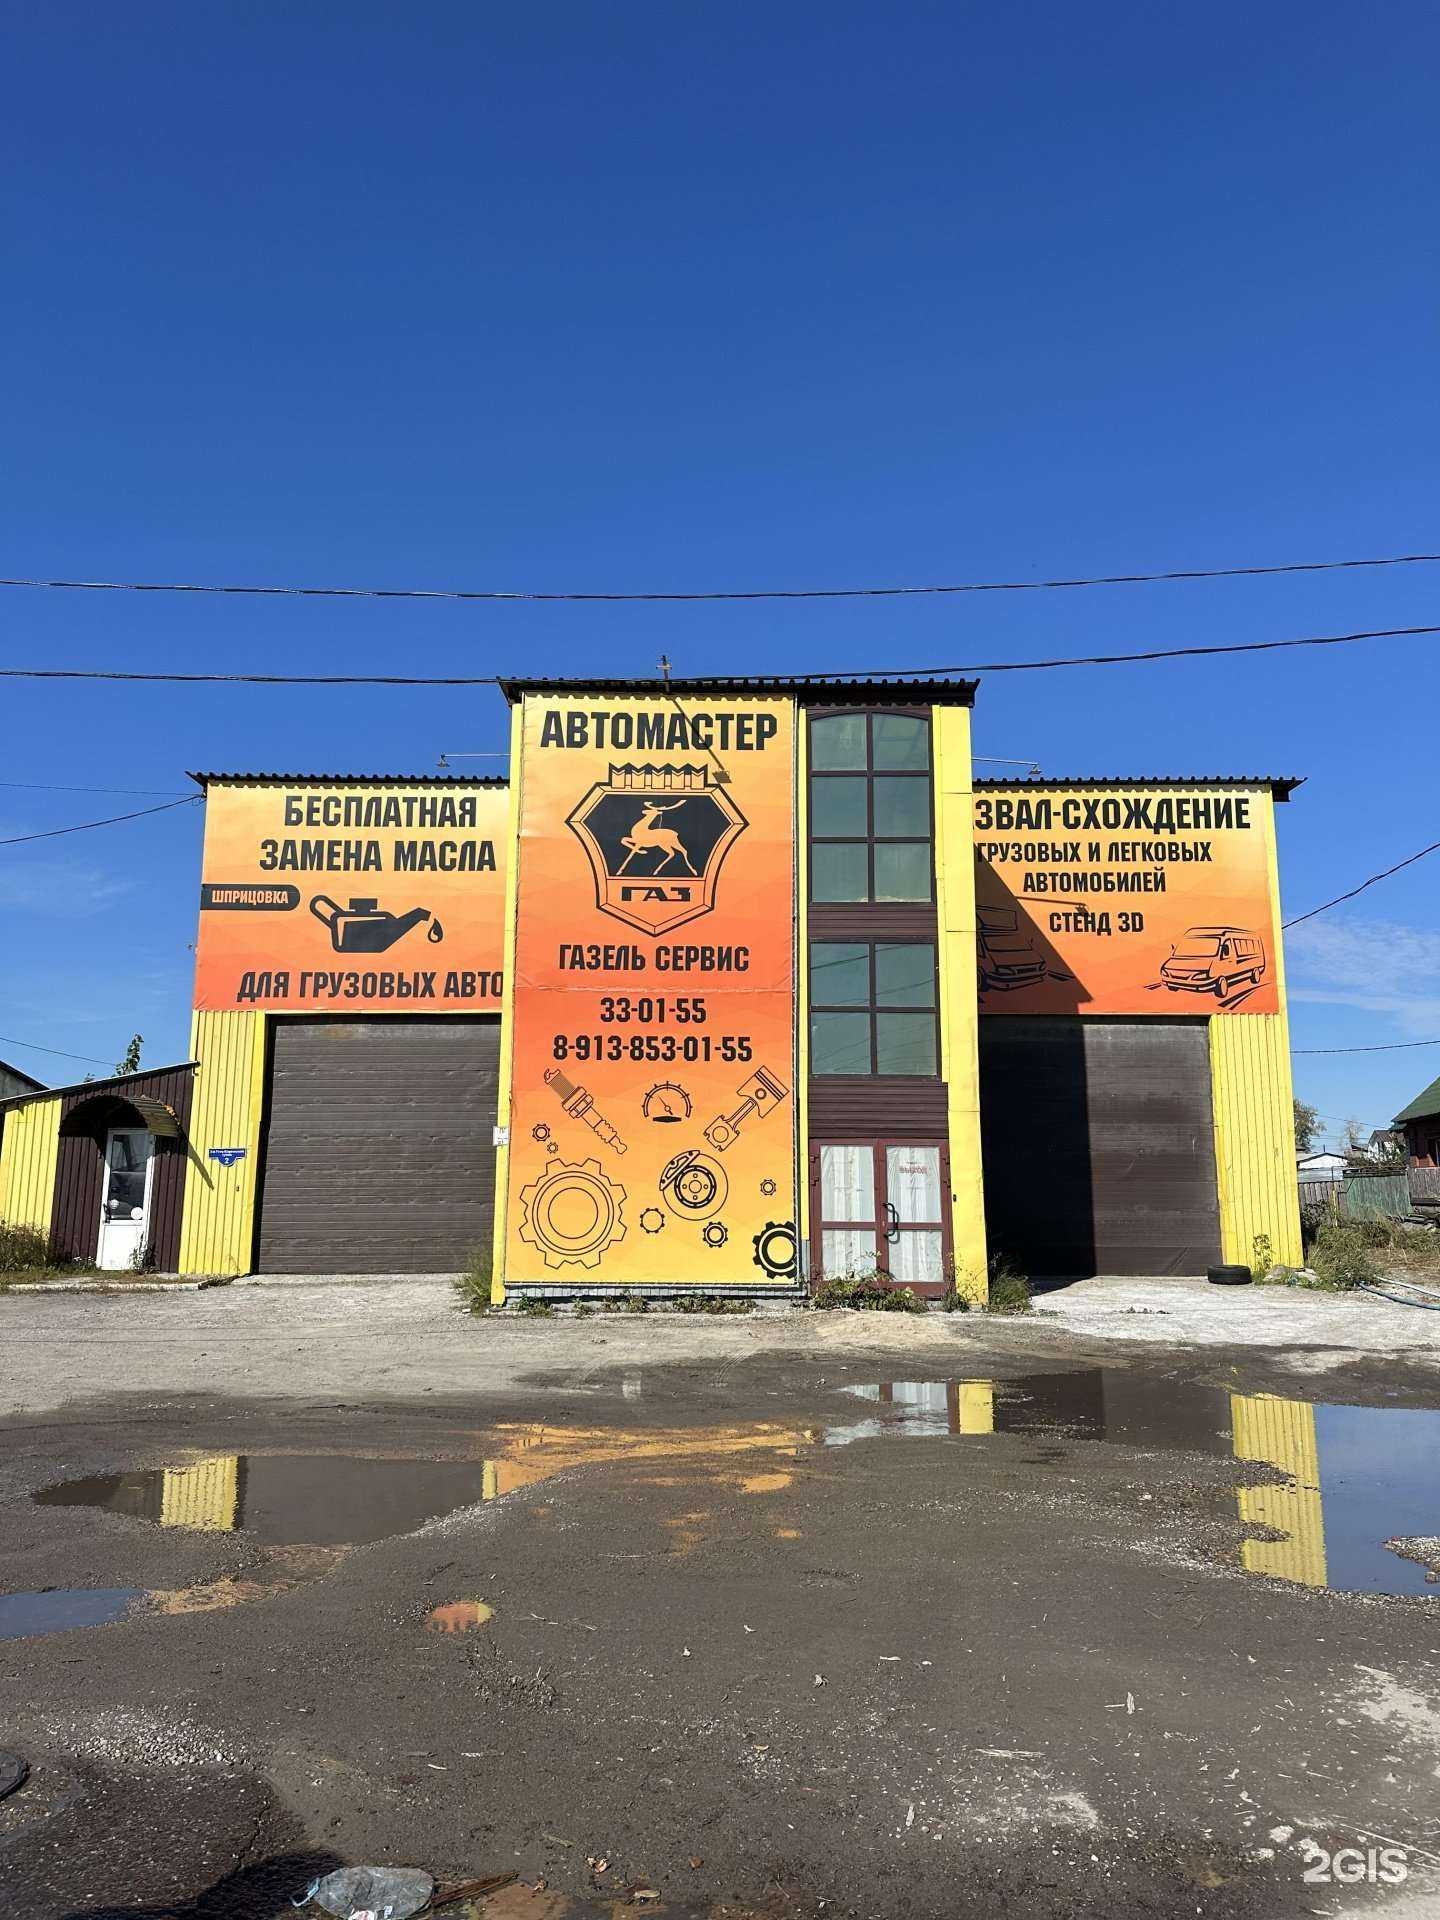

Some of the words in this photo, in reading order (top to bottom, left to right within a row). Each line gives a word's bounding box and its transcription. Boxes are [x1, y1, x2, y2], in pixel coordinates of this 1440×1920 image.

[540, 710, 778, 750] АВТОМАСТЕР
[284, 795, 477, 827] БЕСПЛАТНАЯ
[974, 797, 1251, 835] ЗВАЛ-СХОЖДЕНИЕ
[259, 839, 383, 871] ЗАМЕНА
[393, 840, 497, 871] МАСЛА
[977, 842, 1081, 863] ГРУЗОВЫХ
[1088, 842, 1101, 862] И
[1107, 841, 1212, 862] ЛЕГКОВЫХ
[1023, 866, 1167, 893] АВТОМОБИЛЕЙ
[211, 889, 289, 905] ШПРИЦОВКА
[621, 886, 691, 902] ГАЗ
[1049, 912, 1112, 936] СТЕНД
[1118, 911, 1144, 933] 3D
[559, 944, 646, 971] ГАЗЕЛЬ
[655, 945, 749, 972] СЕРВИС
[237, 971, 290, 1002] ДЛЯ
[299, 971, 437, 998] ГРУЗОВЫХ
[443, 971, 504, 998] АВТО
[600, 997, 707, 1023] 33-01-55
[553, 1034, 752, 1062] 8-913-853-01-55
